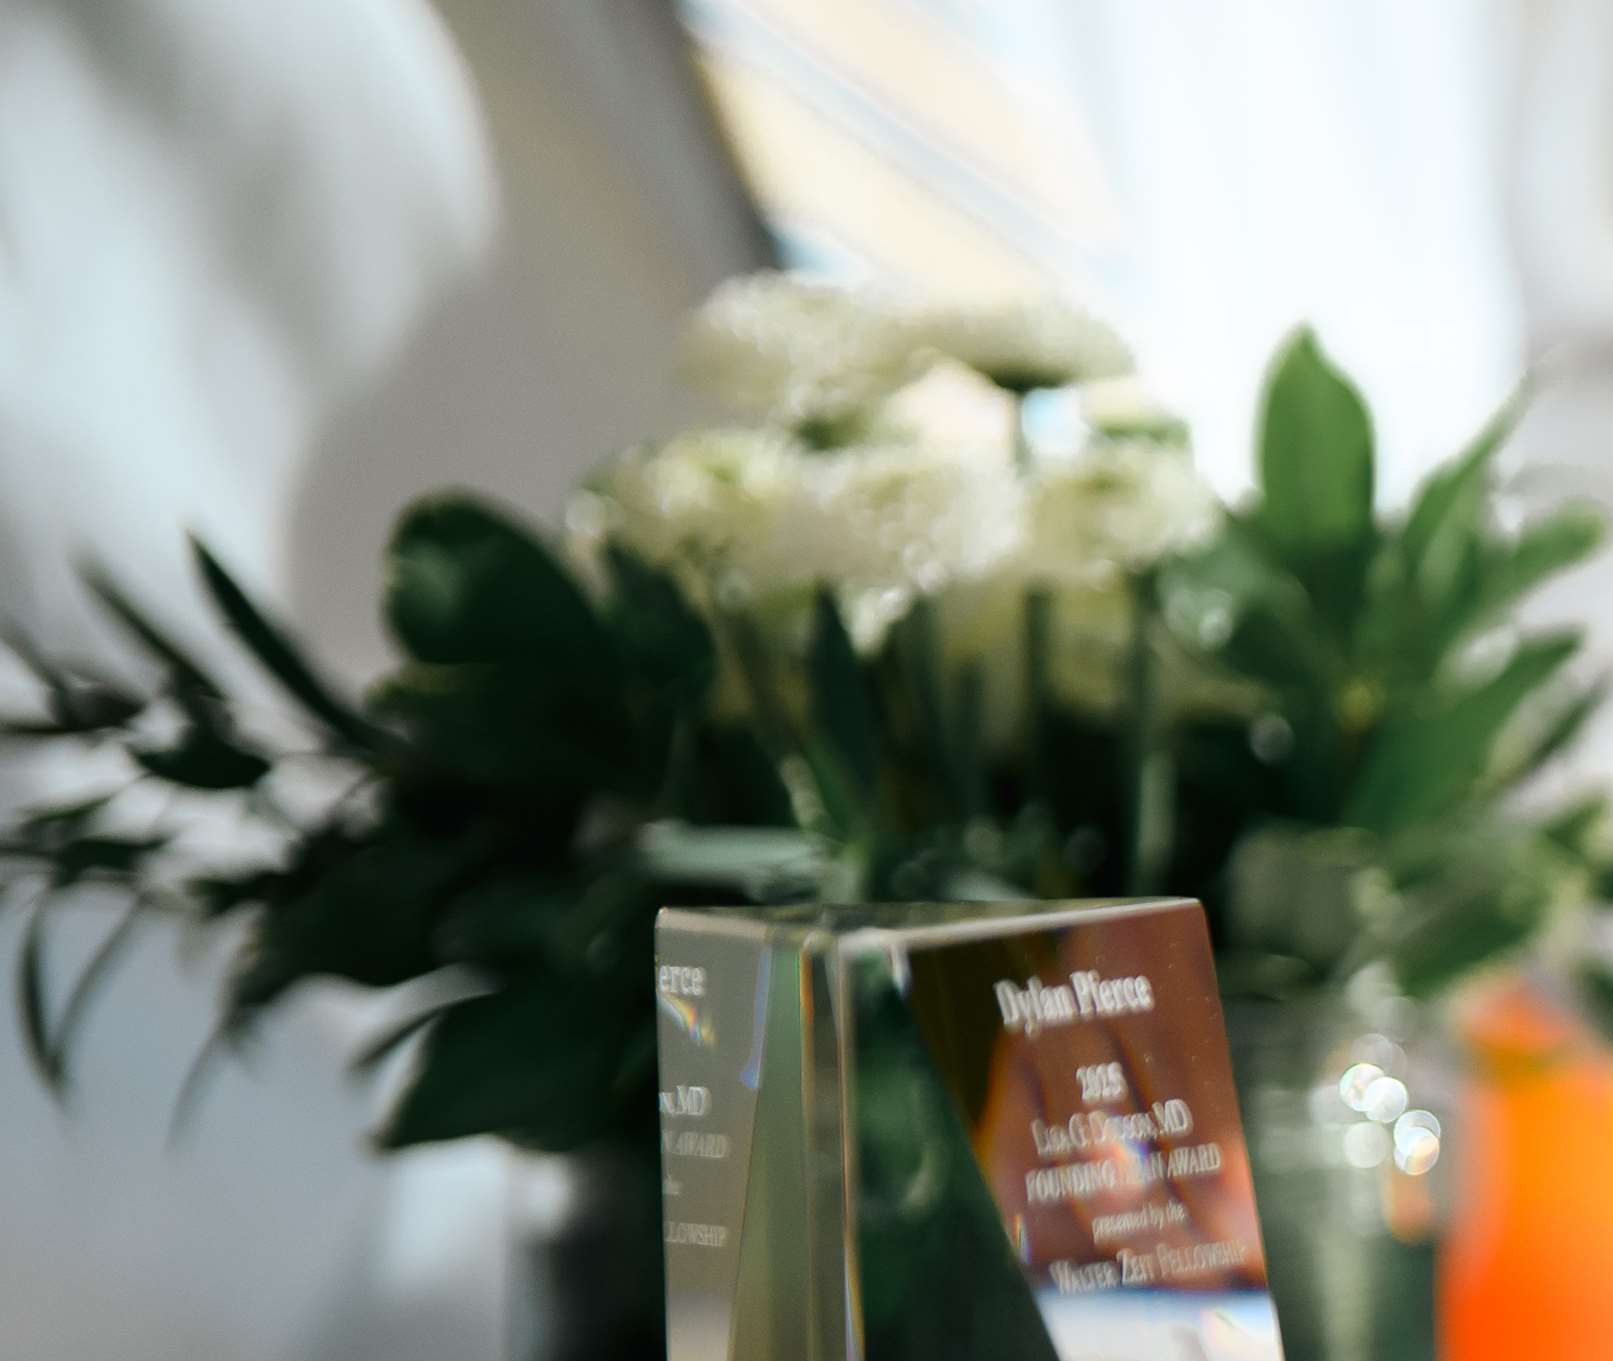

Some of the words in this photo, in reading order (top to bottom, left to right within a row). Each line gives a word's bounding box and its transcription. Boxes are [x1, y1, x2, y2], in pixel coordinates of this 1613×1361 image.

[994, 975, 1075, 1038] Dylan
[1070, 969, 1155, 1018] Pierce
[1025, 1160, 1116, 1204] FOUNDING
[1167, 1142, 1223, 1179] AWARD
